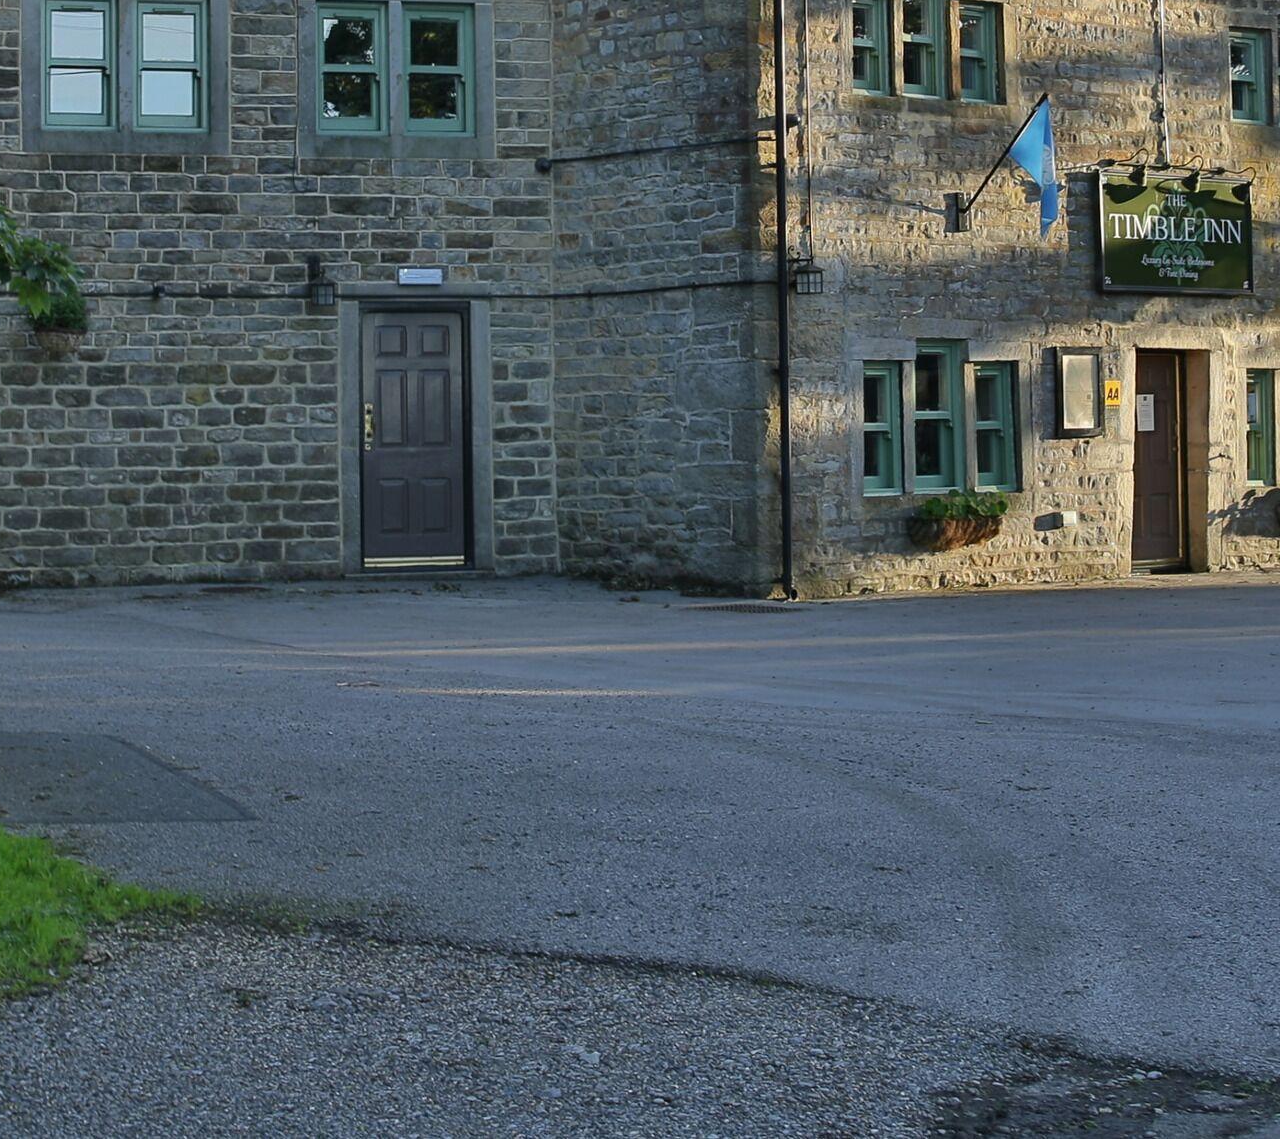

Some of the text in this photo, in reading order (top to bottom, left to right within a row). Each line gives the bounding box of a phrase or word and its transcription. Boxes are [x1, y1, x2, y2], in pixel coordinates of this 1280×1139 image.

[1166, 194, 1187, 207] THE
[1109, 213, 1242, 244] TIMBLE INN
[1107, 387, 1119, 401] AA
